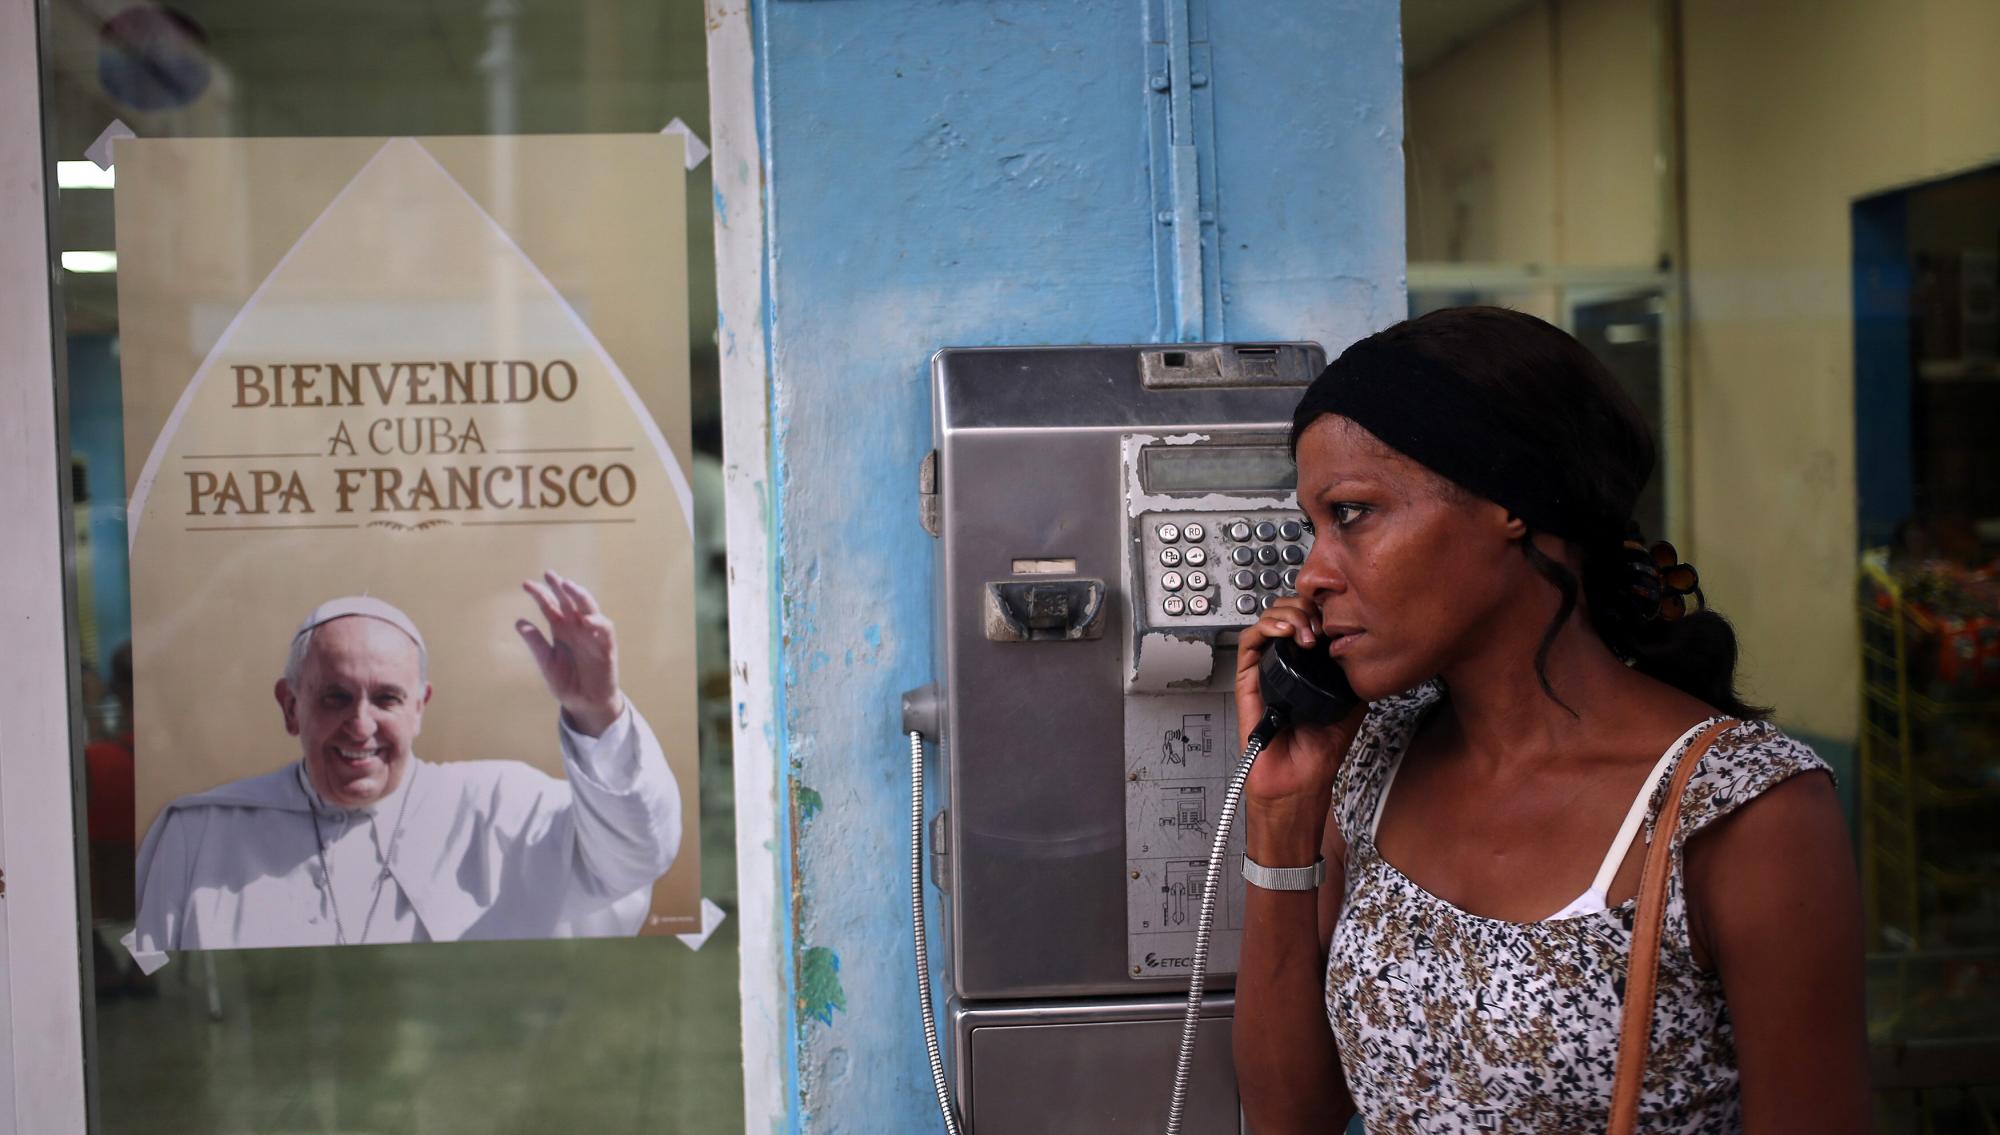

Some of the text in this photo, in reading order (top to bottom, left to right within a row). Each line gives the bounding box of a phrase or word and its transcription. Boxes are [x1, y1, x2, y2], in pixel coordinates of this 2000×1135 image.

[230, 359, 578, 408] BIENVENIDO
[328, 417, 487, 457] A CUBA
[184, 463, 637, 515] PAPA FRANCISCO
[1164, 527, 1201, 536] FC RD
[1169, 576, 1202, 584] A B
[1167, 599, 1203, 608] PTT C
